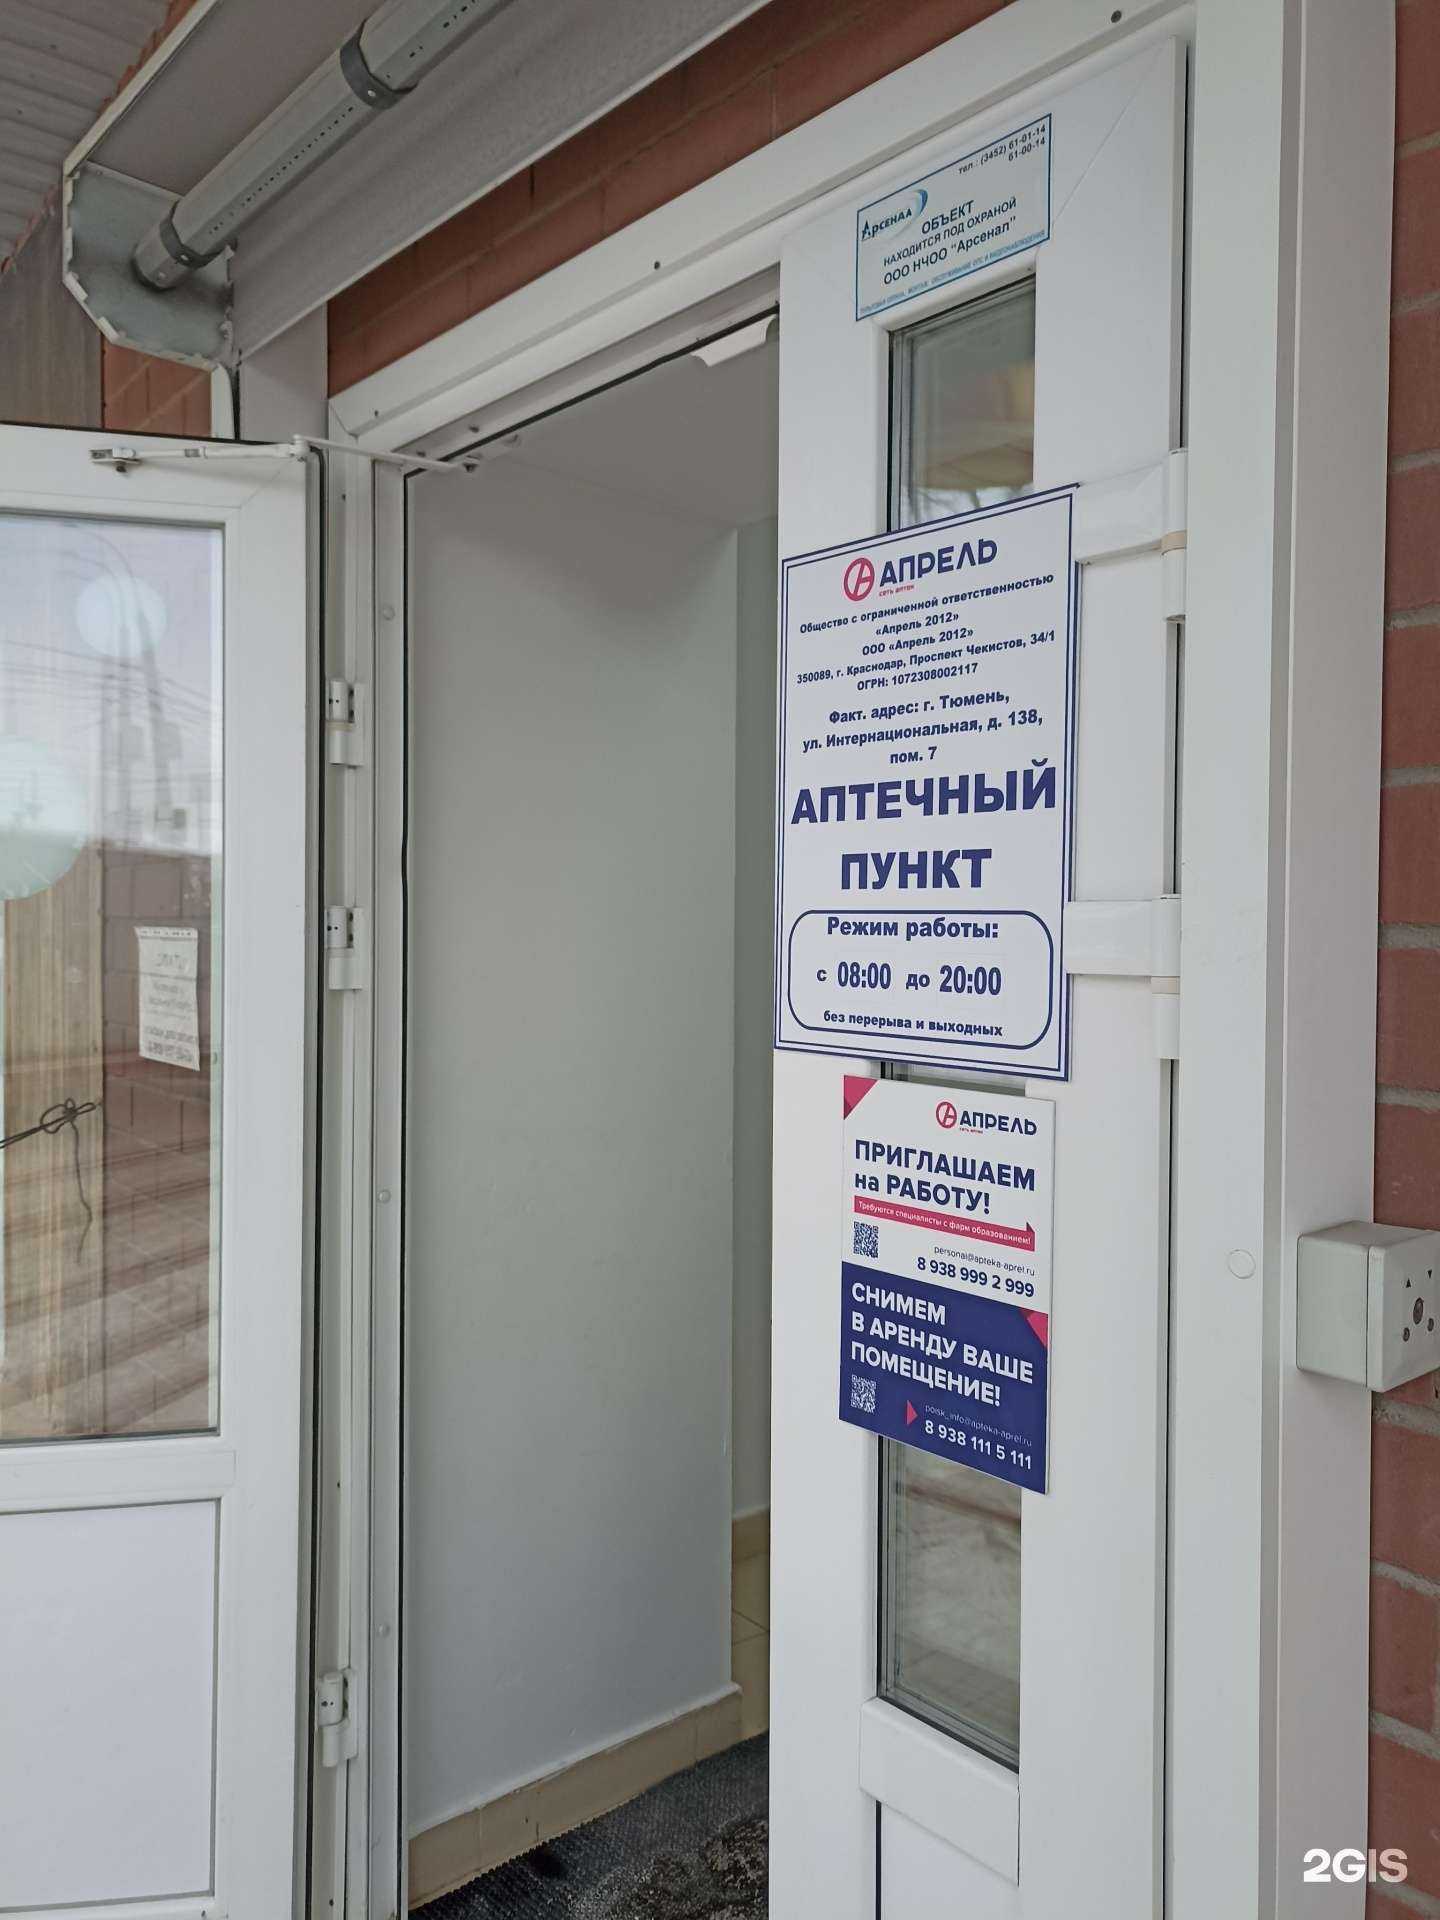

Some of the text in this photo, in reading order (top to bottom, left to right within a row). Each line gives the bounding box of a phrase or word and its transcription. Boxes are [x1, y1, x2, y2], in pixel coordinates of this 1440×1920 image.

[1008, 124, 1045, 149] 61-01-14
[1008, 137, 1045, 162] 61-00-14
[883, 196, 1017, 267] НАХОДИТСЯ ПОД ОХРАНОЙ
[921, 200, 974, 235] ОБЪЕКТ
[883, 264, 910, 285] ООО
[913, 247, 948, 272] НЧОО
[879, 538, 998, 587] АПРЕЛЬ
[799, 572, 1054, 634] Общество с ограниченной ответственностью
[862, 627, 974, 656] ООО «Апрель 2012»
[875, 611, 959, 637] «Апрель 2012»
[796, 630, 1056, 684] 350089, г. Краснодар, Проспект Чекистов, 34/1
[856, 663, 979, 692] ОГРН: 1072308002117
[829, 690, 1010, 725] Факт. адрес: г. Тюмень,
[803, 709, 1043, 753] ул. Интернациональная, д. 138,
[890, 746, 938, 764] пом. 7
[790, 757, 1057, 825] АПТЕЧНЫЙ
[841, 848, 993, 890] ПУНКТ
[827, 916, 999, 941] Режим работы:
[816, 961, 1002, 996] с 08:00 до 20:00
[823, 1010, 1003, 1037] без перерыва и выходных
[959, 1110, 1038, 1136] АПРЕЛЬ
[855, 1139, 1036, 1192] ПРИГЛАШАЕМ
[854, 1173, 990, 1215] на РАБОТУ!
[858, 1201, 895, 1216] Требуются
[895, 1211, 942, 1226] специалисты
[949, 1221, 971, 1233] фарм
[971, 1226, 1032, 1245] образованием!
[917, 1257, 1035, 1297] 8 938 999 2 999
[851, 1282, 946, 1326] СНИМЕМ
[851, 1311, 1033, 1384] В АРЕНДУ ВАШЕ
[851, 1341, 1001, 1407] ПОМЕЩЕНИЕ!
[925, 1420, 1032, 1470] 8 938 111 5 111
